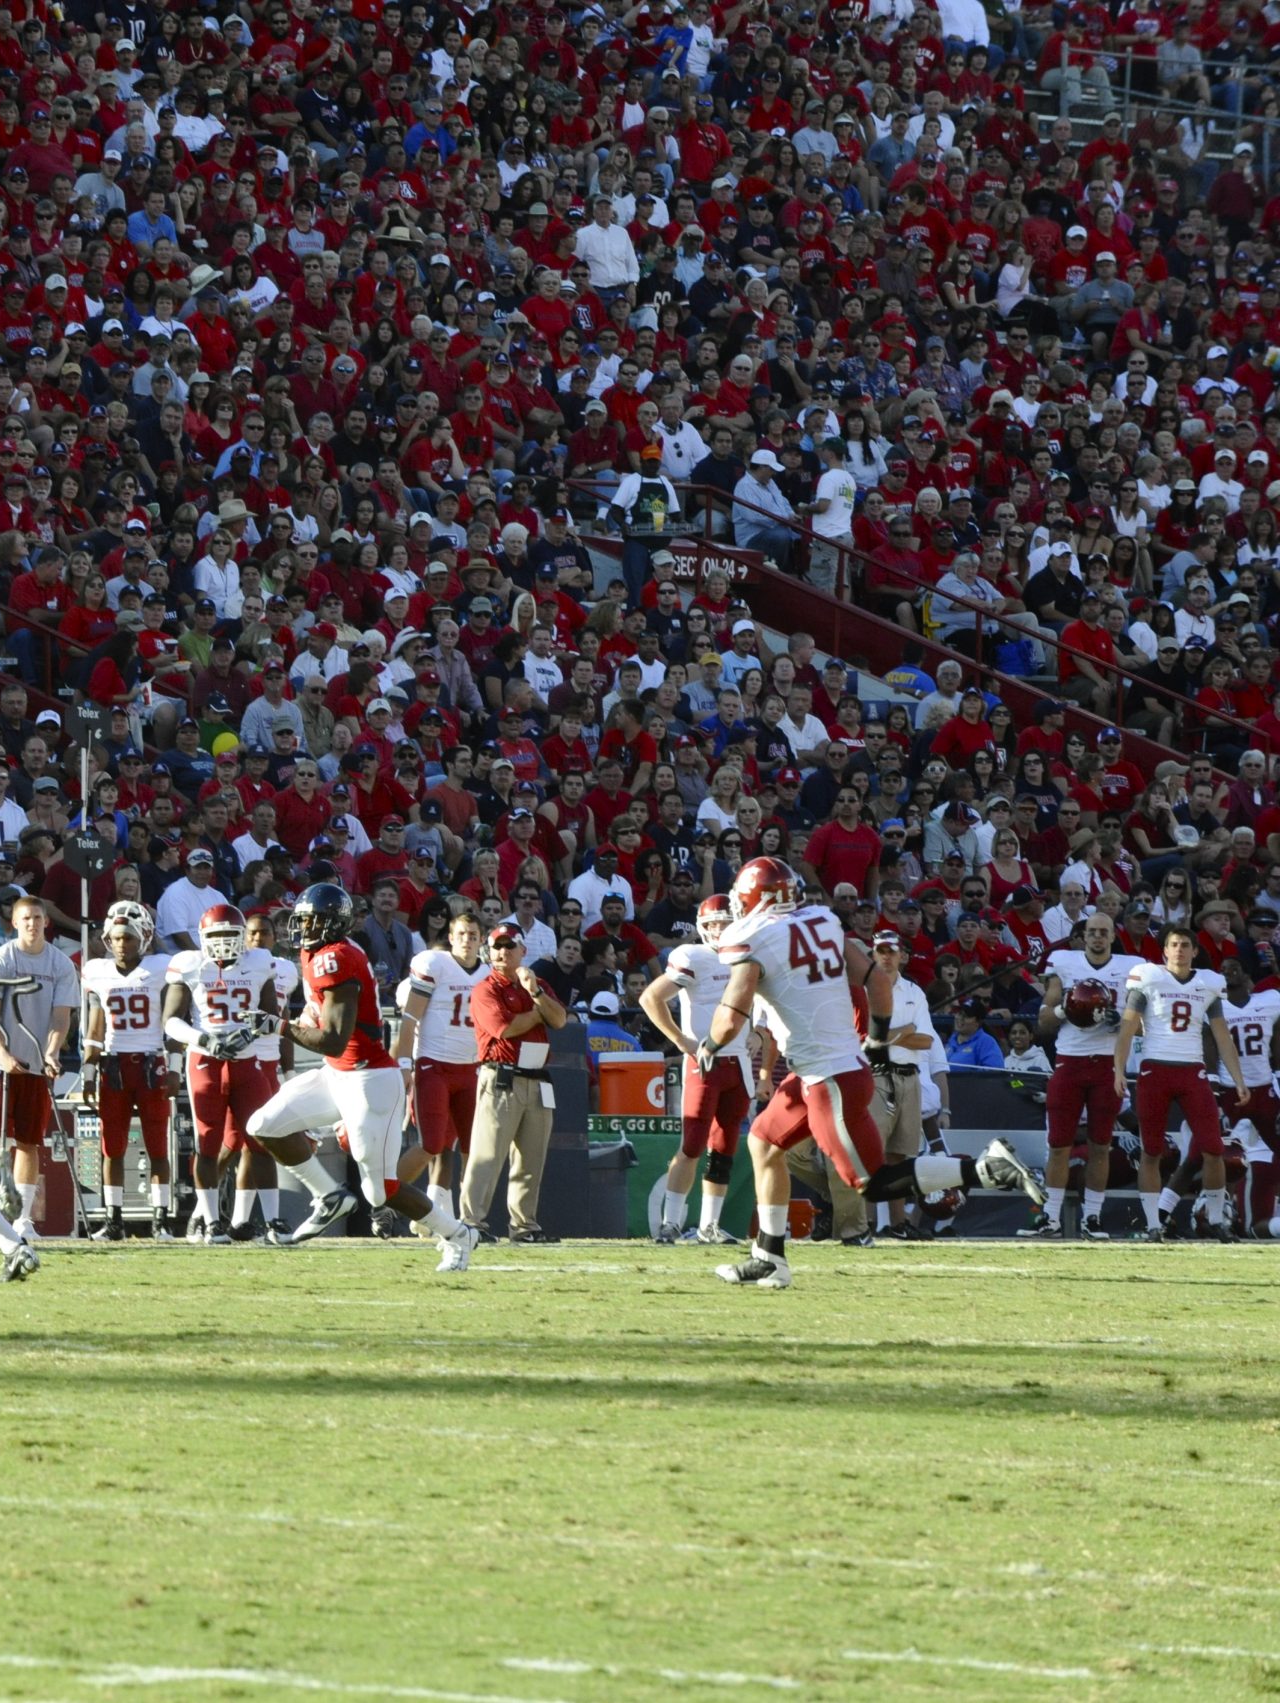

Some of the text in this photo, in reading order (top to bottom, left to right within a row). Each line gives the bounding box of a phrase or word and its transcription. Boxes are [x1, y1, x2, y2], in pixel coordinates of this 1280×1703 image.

[674, 555, 720, 578] SECON
[77, 706, 100, 719] Telex
[77, 838, 100, 849] Telex
[313, 951, 338, 978] 26
[789, 916, 844, 984] 45
[106, 994, 150, 1030] 29
[207, 988, 251, 1024] 53
[1160, 992, 1205, 1003] WASHINGTON STATE
[1171, 1000, 1191, 1033] 8
[1230, 1023, 1263, 1056] 12
